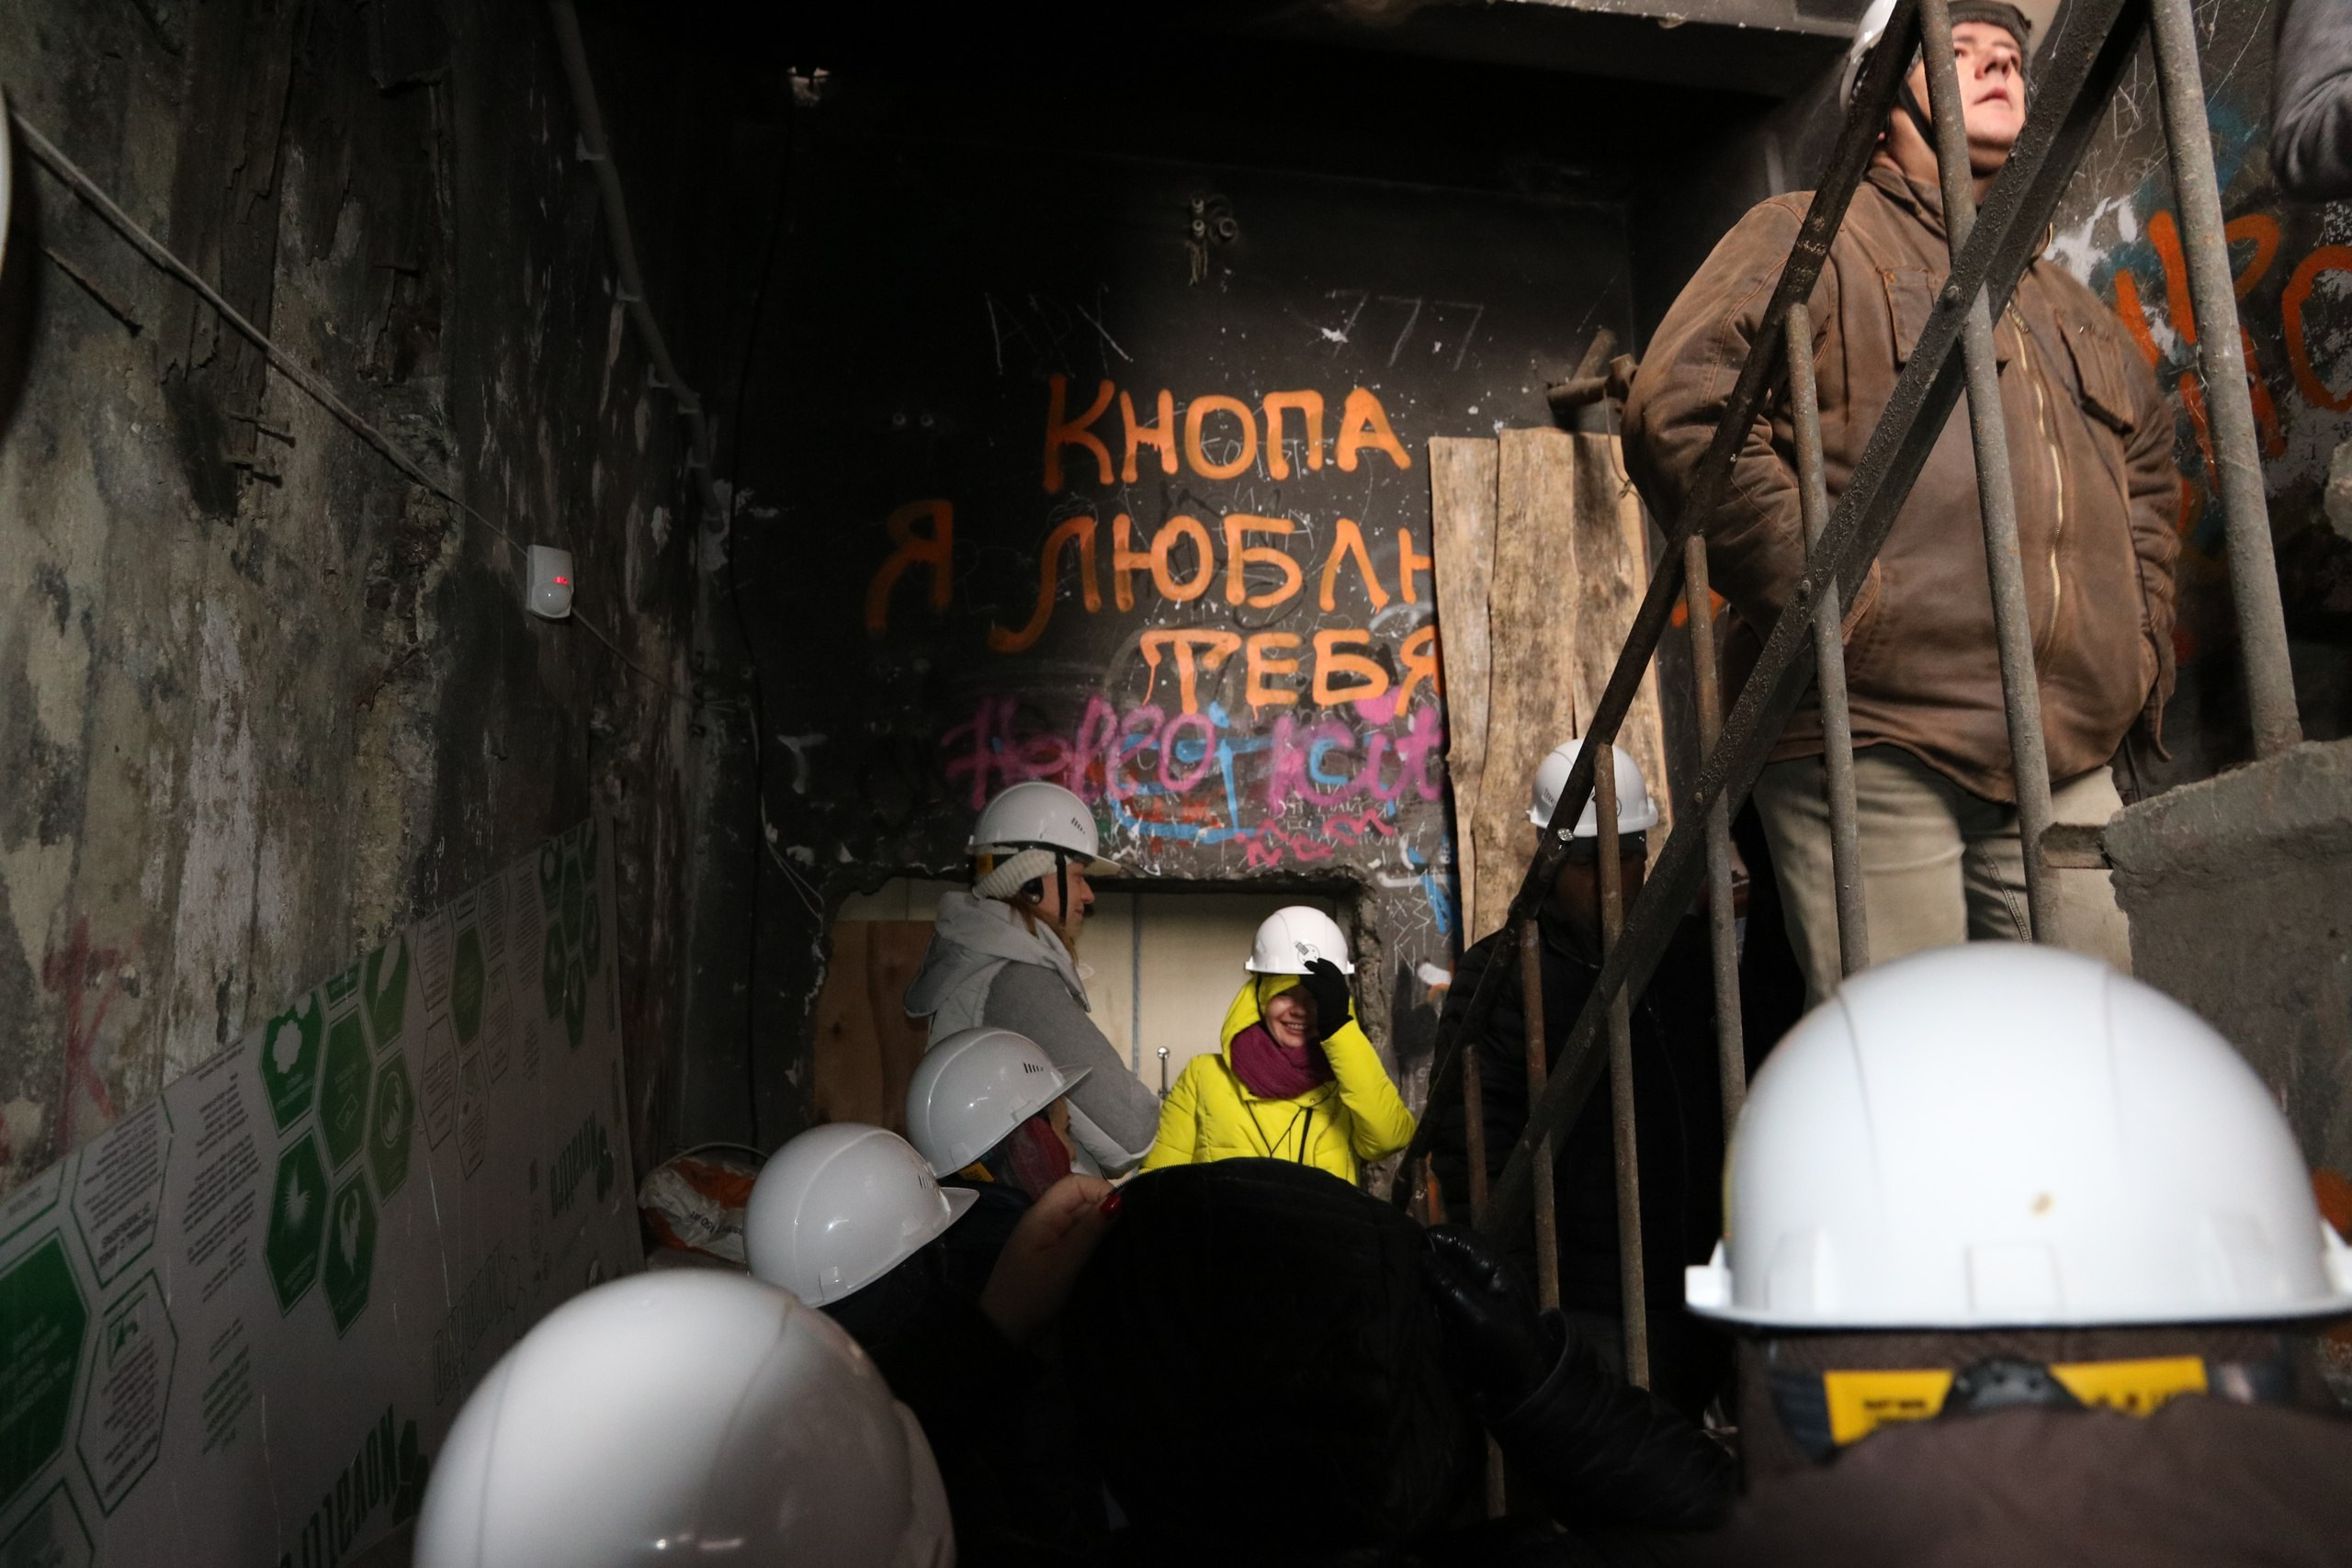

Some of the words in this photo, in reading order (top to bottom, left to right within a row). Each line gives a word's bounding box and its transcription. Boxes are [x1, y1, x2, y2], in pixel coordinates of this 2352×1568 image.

[1043, 372, 1411, 494] КНОПА
[863, 498, 955, 640] Я
[1139, 626, 1441, 716] ТЕБЯ
